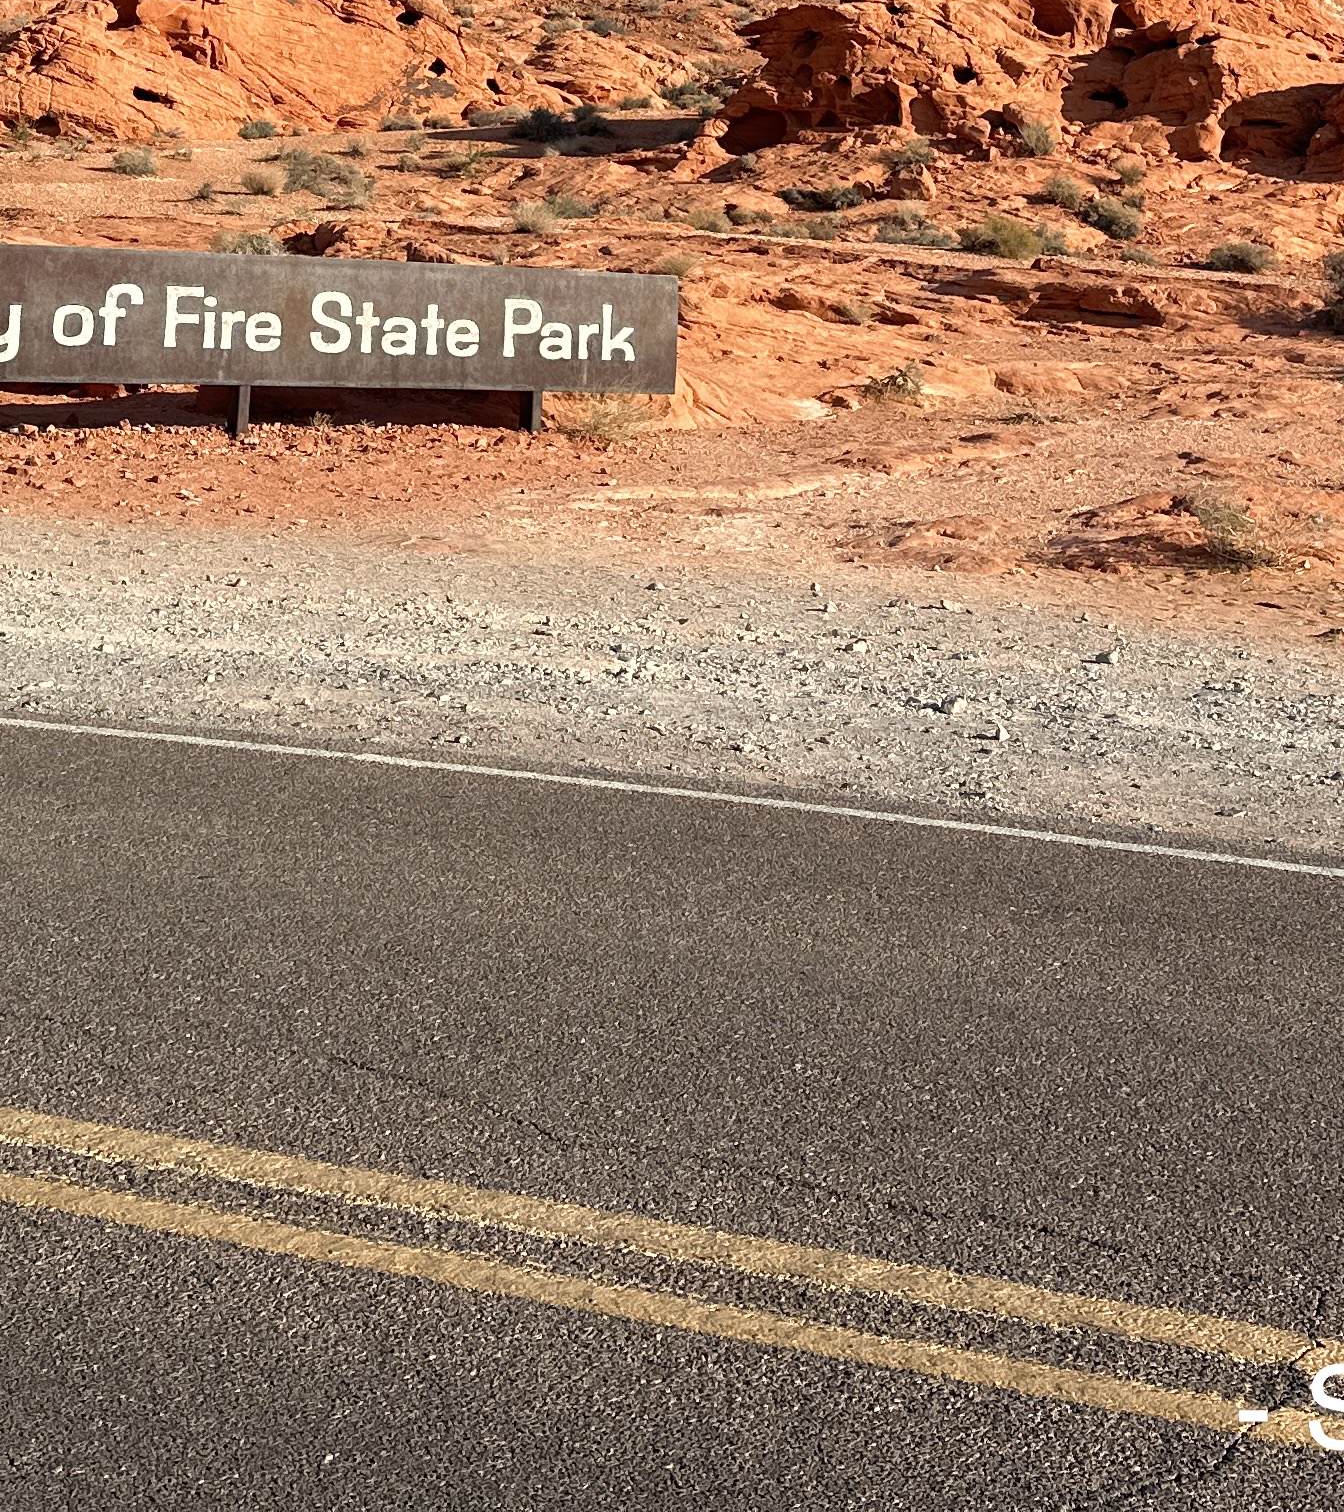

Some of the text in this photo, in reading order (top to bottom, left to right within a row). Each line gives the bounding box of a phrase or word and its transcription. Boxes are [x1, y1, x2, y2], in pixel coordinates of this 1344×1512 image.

[52, 283, 145, 348] of
[163, 285, 282, 353] Fire
[309, 290, 480, 358] State
[502, 298, 636, 363] Park
